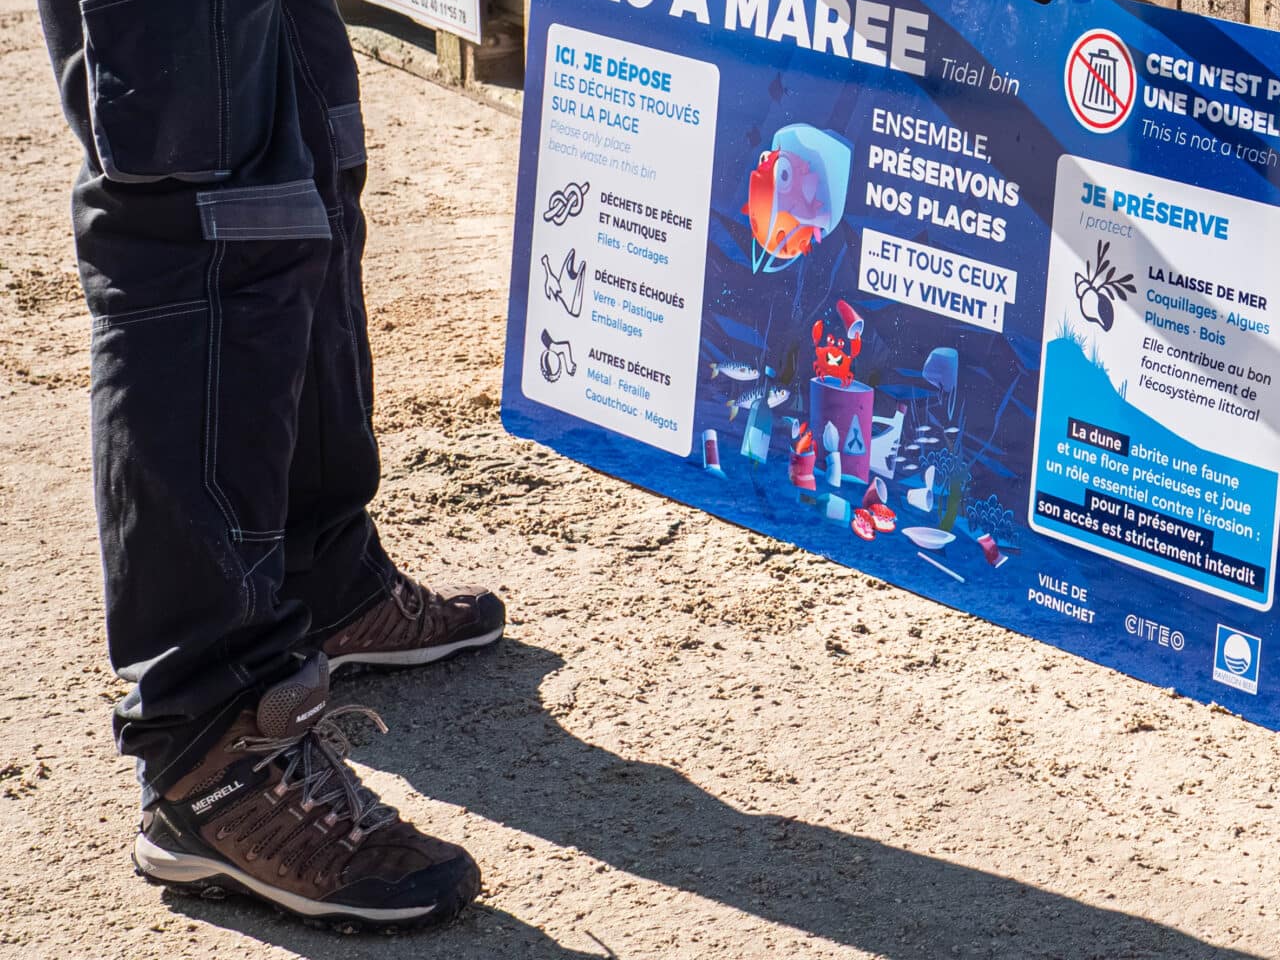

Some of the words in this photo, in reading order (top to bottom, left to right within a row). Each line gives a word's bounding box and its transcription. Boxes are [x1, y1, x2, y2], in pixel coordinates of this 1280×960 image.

[555, 44, 579, 70] ICI,
[583, 52, 602, 74] JE
[607, 57, 672, 92] DÉPOSE
[940, 57, 984, 88] Tidal
[988, 67, 1020, 96] bin
[1146, 52, 1193, 83] CECI
[1200, 64, 1263, 98] N'EST
[552, 96, 576, 116] SUR
[580, 103, 595, 121] LA
[599, 108, 640, 134] PLAGE
[553, 72, 575, 90] LES
[579, 77, 636, 108] DÉCHETS
[639, 94, 700, 125] TROUVÉS
[1143, 85, 1188, 116] UNE
[550, 119, 581, 138] Please
[582, 131, 602, 145] only
[603, 136, 632, 154] place
[872, 108, 992, 163] ENSEMBLE,
[1141, 118, 1171, 143] This
[1174, 126, 1186, 146] is
[1190, 133, 1216, 153] not
[1220, 141, 1231, 156] a
[1236, 142, 1277, 169] trash
[548, 137, 578, 157] beach
[580, 148, 608, 166] waste
[610, 157, 620, 168] in
[621, 159, 639, 176] this
[640, 165, 657, 181] bin
[868, 145, 1020, 207] PRÉSERVONS
[599, 212, 611, 224] ET
[612, 215, 667, 243] NAUTIQUES
[600, 192, 643, 215] DÉCHETS
[645, 206, 658, 220] DE
[660, 208, 693, 231] PÊCHE
[866, 182, 912, 216] NOS
[917, 196, 1007, 242] PLAGES
[1081, 182, 1107, 208] JE
[1112, 192, 1229, 241] PRÉSERVE
[1085, 215, 1134, 239] protect
[597, 232, 621, 250] Filets
[626, 242, 669, 265] Cordages
[595, 269, 637, 293] DÉCHETS
[639, 282, 685, 309] ÉCHOUÉS
[906, 247, 953, 278] TOUS
[958, 263, 1008, 295] CEUX
[1148, 266, 1165, 283] LA
[1168, 271, 1213, 296] LAISSE
[1216, 285, 1235, 302] DE
[1238, 290, 1267, 311] MER
[593, 291, 616, 308] Verre
[622, 300, 664, 324] Plastique
[866, 268, 897, 291] QUI
[903, 277, 914, 297] Y
[919, 282, 987, 320] VIVENT
[992, 305, 998, 323] !
[1146, 289, 1217, 320] Coquillages
[1226, 312, 1270, 335] Algues
[591, 310, 643, 338] Emballages
[1145, 311, 1190, 335] Plumes
[1199, 327, 1226, 346] Bois
[587, 368, 612, 386] Métal
[588, 348, 625, 370] AUTRES
[627, 360, 671, 386] DÉCHETS
[1140, 356, 1238, 397] fonctionnement
[1241, 386, 1257, 401] de
[1142, 337, 1164, 353] Elle
[1166, 346, 1225, 372] contribue
[1227, 363, 1244, 378] au
[1247, 367, 1272, 386] bon
[585, 388, 638, 417] Caoutchouc
[645, 410, 678, 431] Mégots
[1139, 374, 1215, 409] l'écosystème
[1218, 398, 1260, 422] littoral
[1071, 422, 1087, 440] La
[1089, 428, 1122, 452] dune
[1130, 443, 1170, 466] abrite
[1172, 457, 1198, 476] une
[1201, 464, 1240, 490] faune
[1046, 461, 1063, 476] un
[1065, 465, 1090, 484] rôle
[1092, 476, 1149, 504] essentiel
[1152, 496, 1195, 519] contre
[1197, 506, 1253, 540] l'érosion
[1057, 442, 1070, 456] et
[1073, 448, 1097, 464] une
[1100, 453, 1130, 475] flore
[1132, 466, 1201, 499] précieuses
[1204, 490, 1218, 505] et
[1220, 494, 1252, 516] joue
[1090, 495, 1121, 516] pour
[1124, 504, 1136, 521] la
[1138, 511, 1205, 546] préserver,
[1038, 500, 1060, 518] son
[1063, 508, 1099, 531] accès
[1102, 522, 1122, 539] est
[1124, 528, 1202, 567] strictement
[1204, 554, 1256, 586] interdit
[1028, 588, 1096, 624] PORNICHET
[1038, 573, 1068, 595] VILLE
[1071, 583, 1088, 603] DE
[1125, 614, 1185, 651] CITEO
[191, 780, 245, 812] MERRELL
